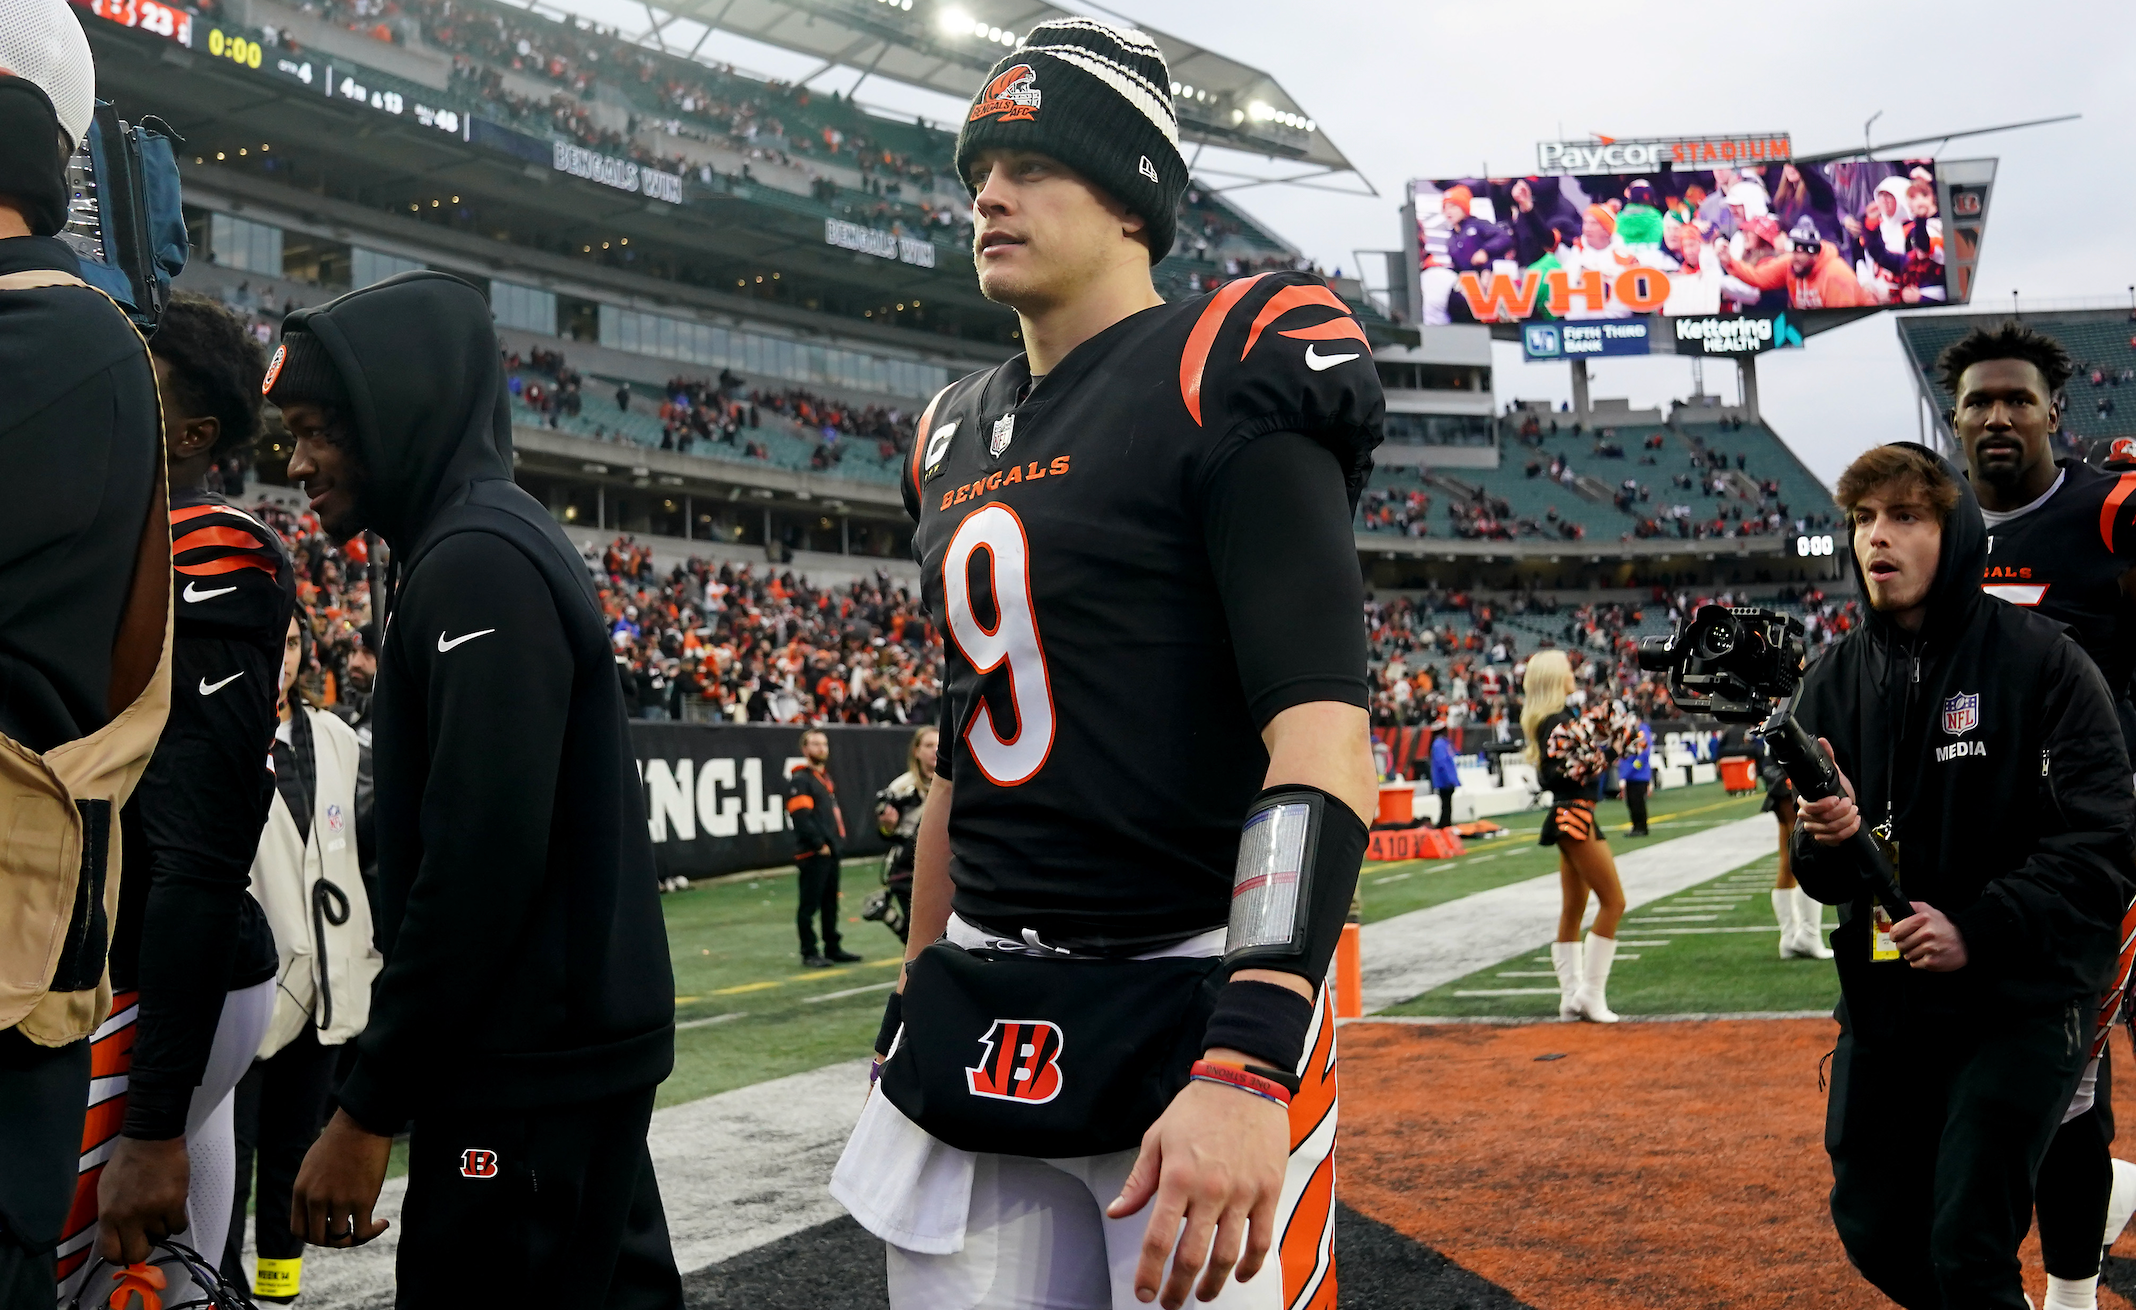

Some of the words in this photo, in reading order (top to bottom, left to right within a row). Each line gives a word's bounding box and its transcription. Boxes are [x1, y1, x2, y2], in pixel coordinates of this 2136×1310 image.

[140, 2, 174, 36] 23
[208, 28, 262, 69] 0:00
[297, 62, 312, 84] 4
[972, 101, 1011, 119] BENGALS
[1010, 107, 1029, 117] AFC
[1539, 142, 1665, 173] Paycor
[1671, 138, 1790, 163] STADIUM
[553, 140, 640, 192] BENGALS
[641, 166, 682, 205] WIN
[825, 217, 898, 260] BENGALS
[898, 236, 935, 268] WIN
[1460, 267, 1671, 320] WHO
[1563, 326, 1602, 341] FIFTH
[1603, 324, 1646, 339] THIRD
[1676, 316, 1772, 341] Kettering
[1564, 339, 1603, 353] BANK
[1703, 338, 1760, 352] HEALTH
[925, 422, 957, 471] C
[940, 455, 1070, 512] BENGALS
[943, 501, 1056, 787] 9
[1947, 710, 1974, 730] NFL
[1936, 741, 1986, 762] MEDIA
[965, 1019, 1064, 1104] B
[1206, 1064, 1247, 1083] STRONG
[1250, 1079, 1271, 1091] ONE
[460, 1149, 498, 1178] B
